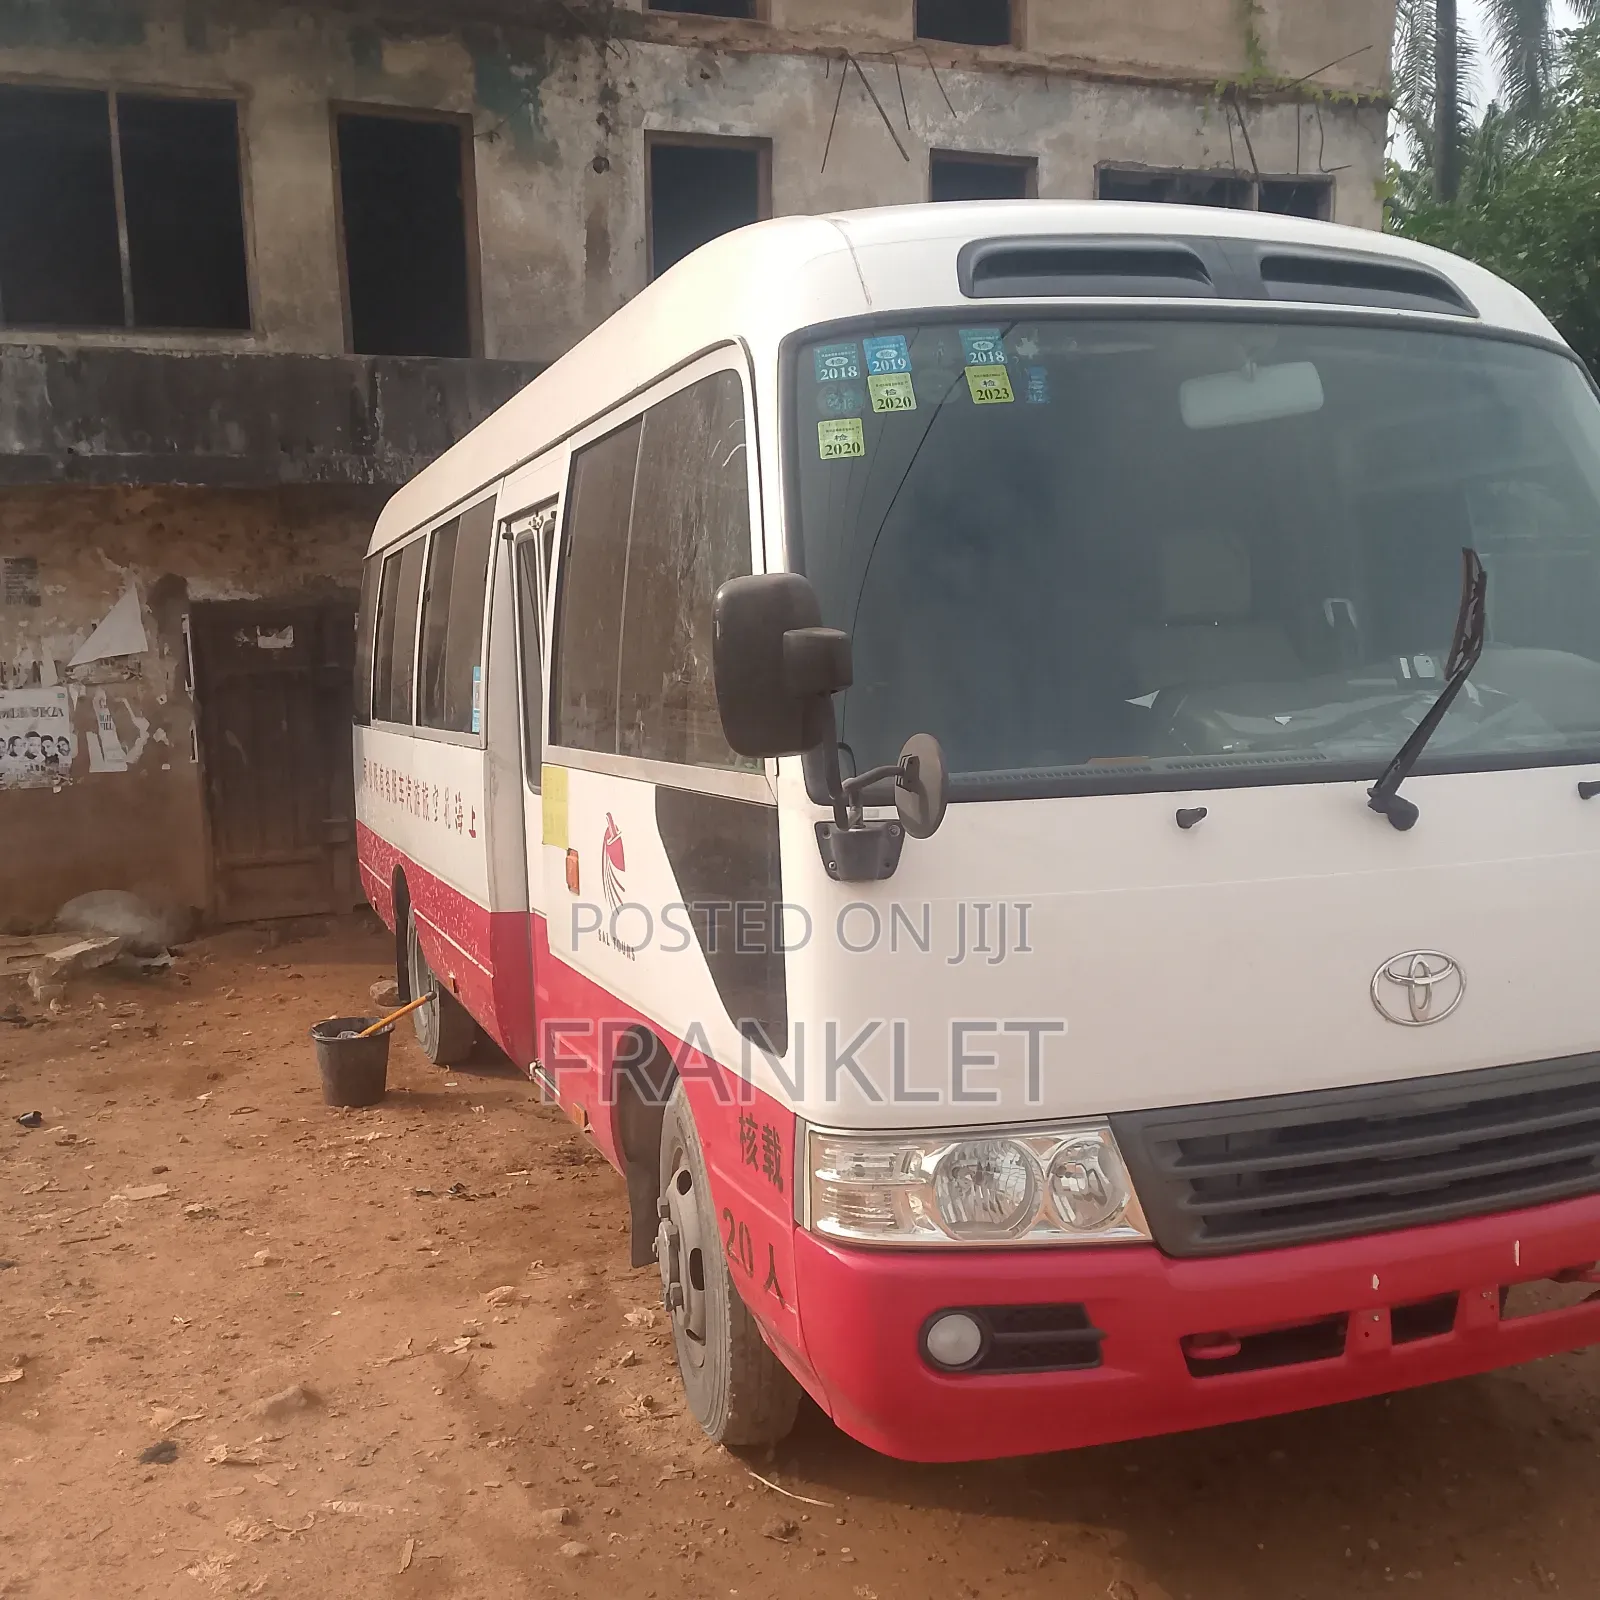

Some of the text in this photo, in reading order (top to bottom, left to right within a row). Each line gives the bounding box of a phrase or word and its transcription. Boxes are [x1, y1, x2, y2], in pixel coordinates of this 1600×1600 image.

[969, 351, 1004, 364] 2018
[872, 358, 907, 372] 2019
[820, 366, 858, 381] 2018
[976, 387, 1010, 401] 2023
[877, 396, 912, 410] 2020
[825, 441, 861, 456] 2020
[598, 928, 636, 962] SAL TOURS
[738, 1106, 784, 1194] 核载
